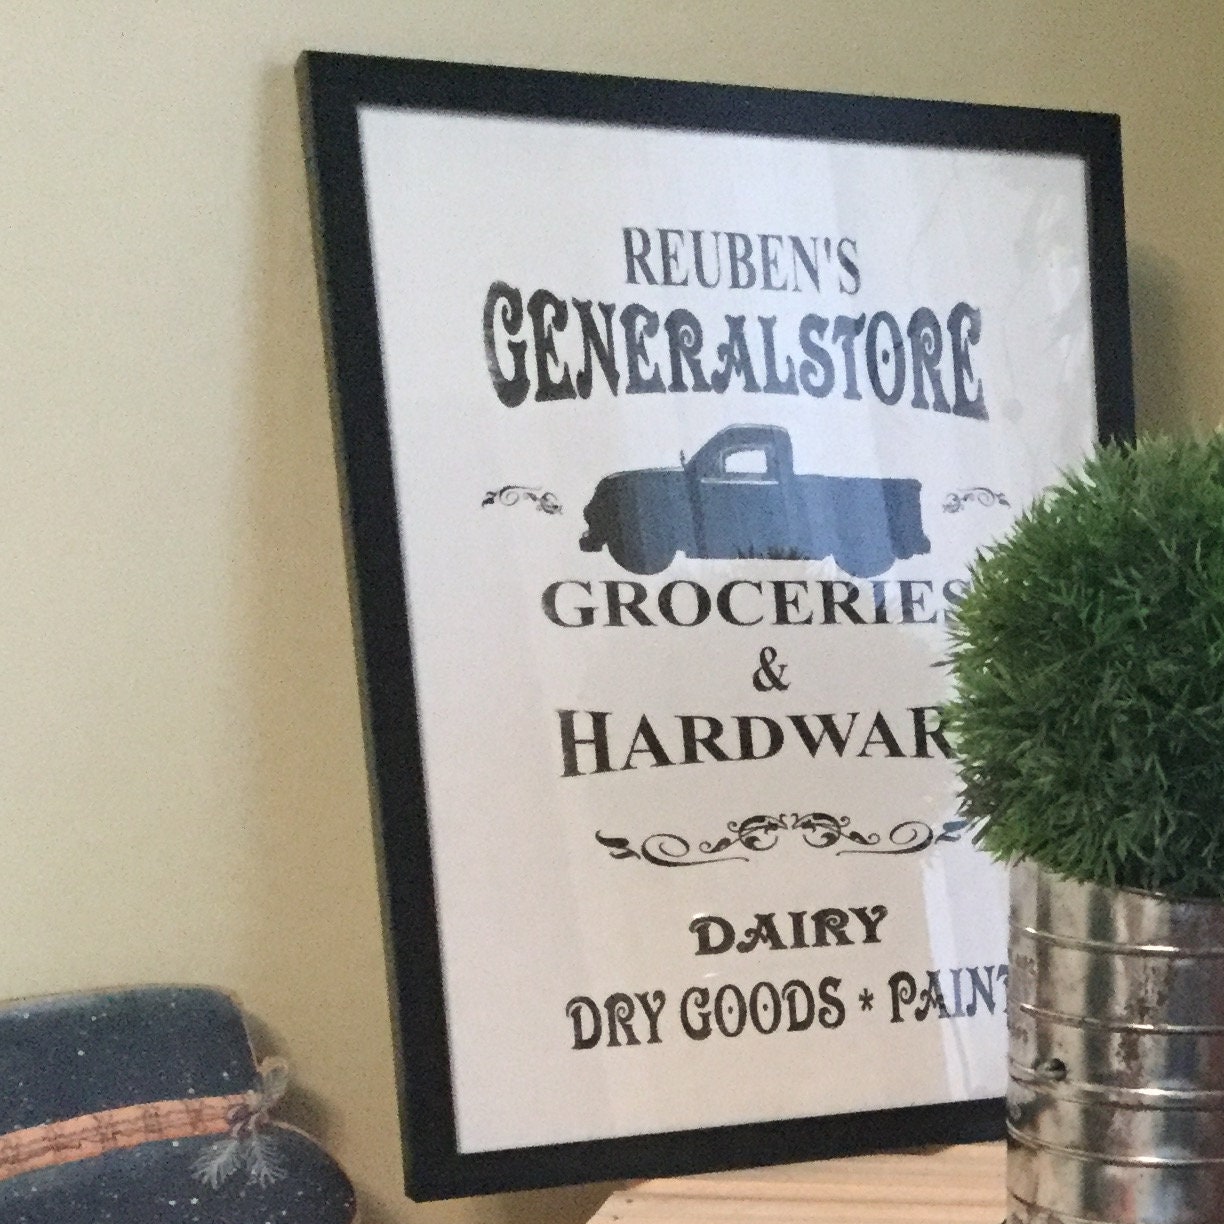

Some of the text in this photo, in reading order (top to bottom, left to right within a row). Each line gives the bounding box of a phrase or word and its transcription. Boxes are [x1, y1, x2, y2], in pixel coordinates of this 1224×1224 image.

[621, 226, 862, 295] REUBEN'S
[752, 646, 790, 692] &
[556, 706, 958, 777] HARDWAR
[689, 905, 888, 955] DAIRY
[565, 990, 666, 1049] DRY
[680, 976, 846, 1040] GOODS
